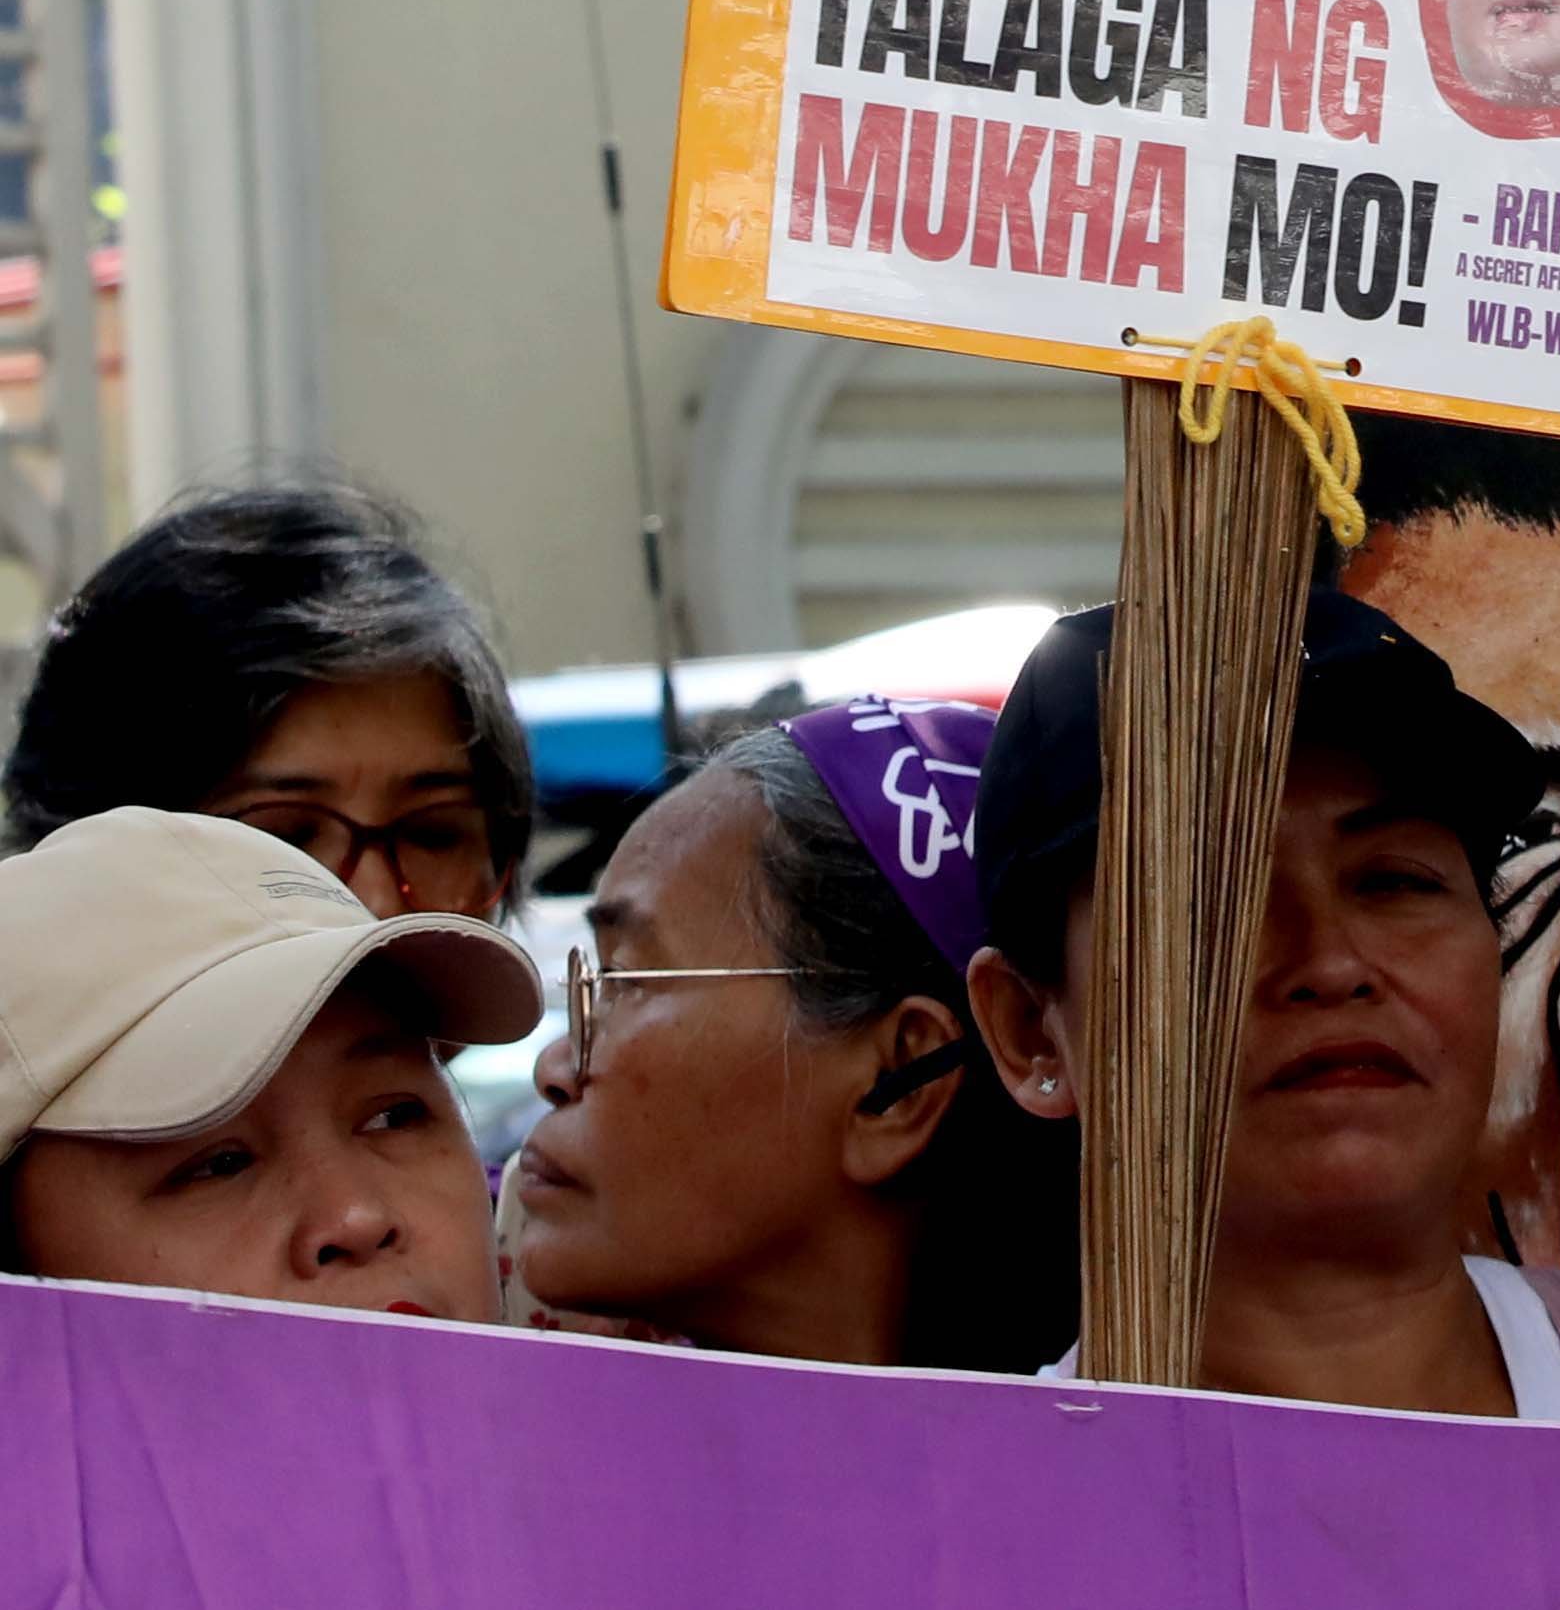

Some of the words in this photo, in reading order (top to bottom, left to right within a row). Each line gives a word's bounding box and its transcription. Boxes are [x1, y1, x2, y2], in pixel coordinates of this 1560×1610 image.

[788, 93, 1187, 294] MUKHA
[1221, 154, 1439, 328] MO!
[1456, 252, 1468, 277] A
[1472, 255, 1534, 288] SECRET
